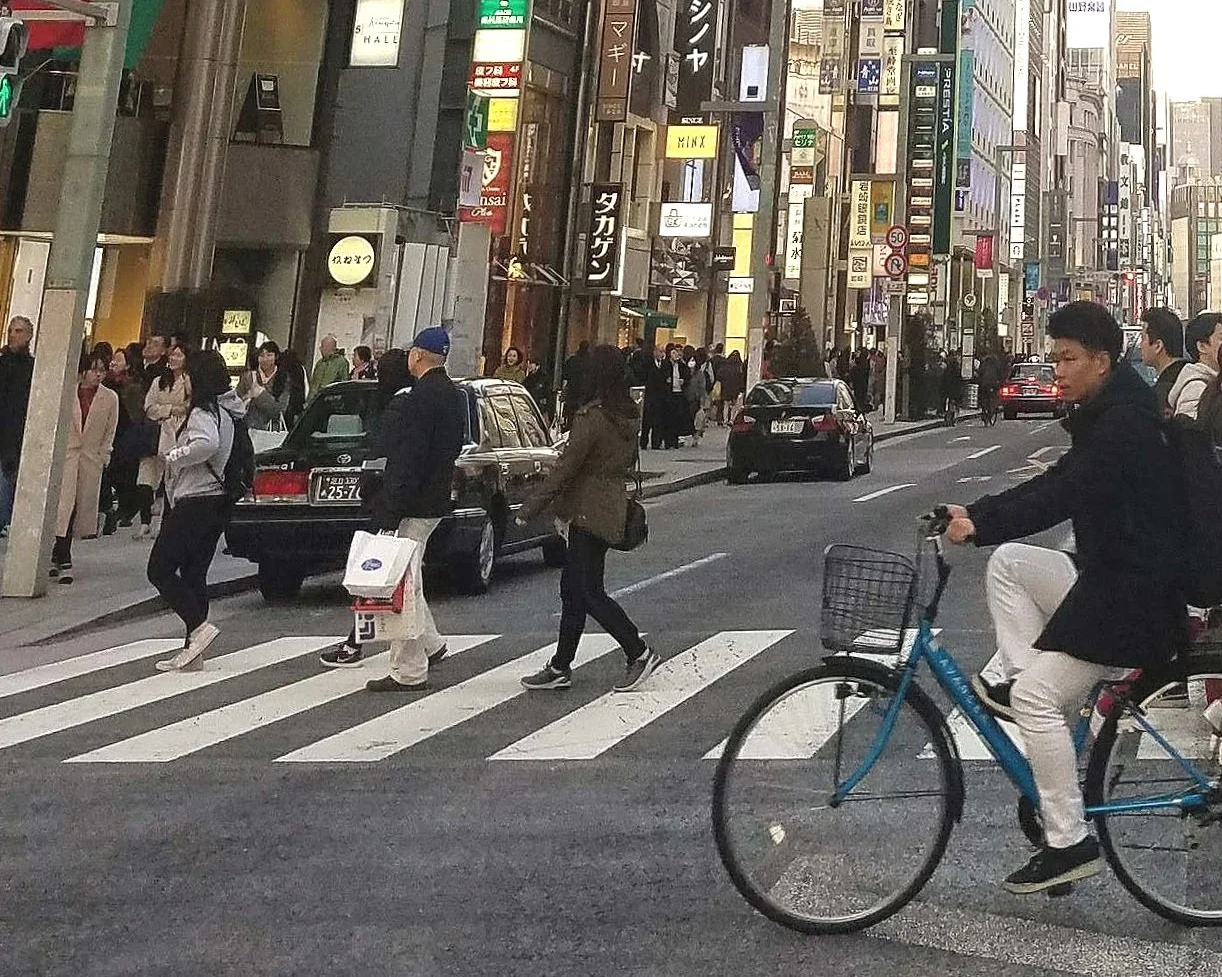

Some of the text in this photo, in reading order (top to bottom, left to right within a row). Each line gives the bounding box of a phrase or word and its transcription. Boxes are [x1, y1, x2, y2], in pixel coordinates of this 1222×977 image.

[606, 21, 628, 87] マギー
[677, 135, 706, 149] MINX
[587, 191, 618, 281] タカゲン
[890, 231, 904, 243] 50
